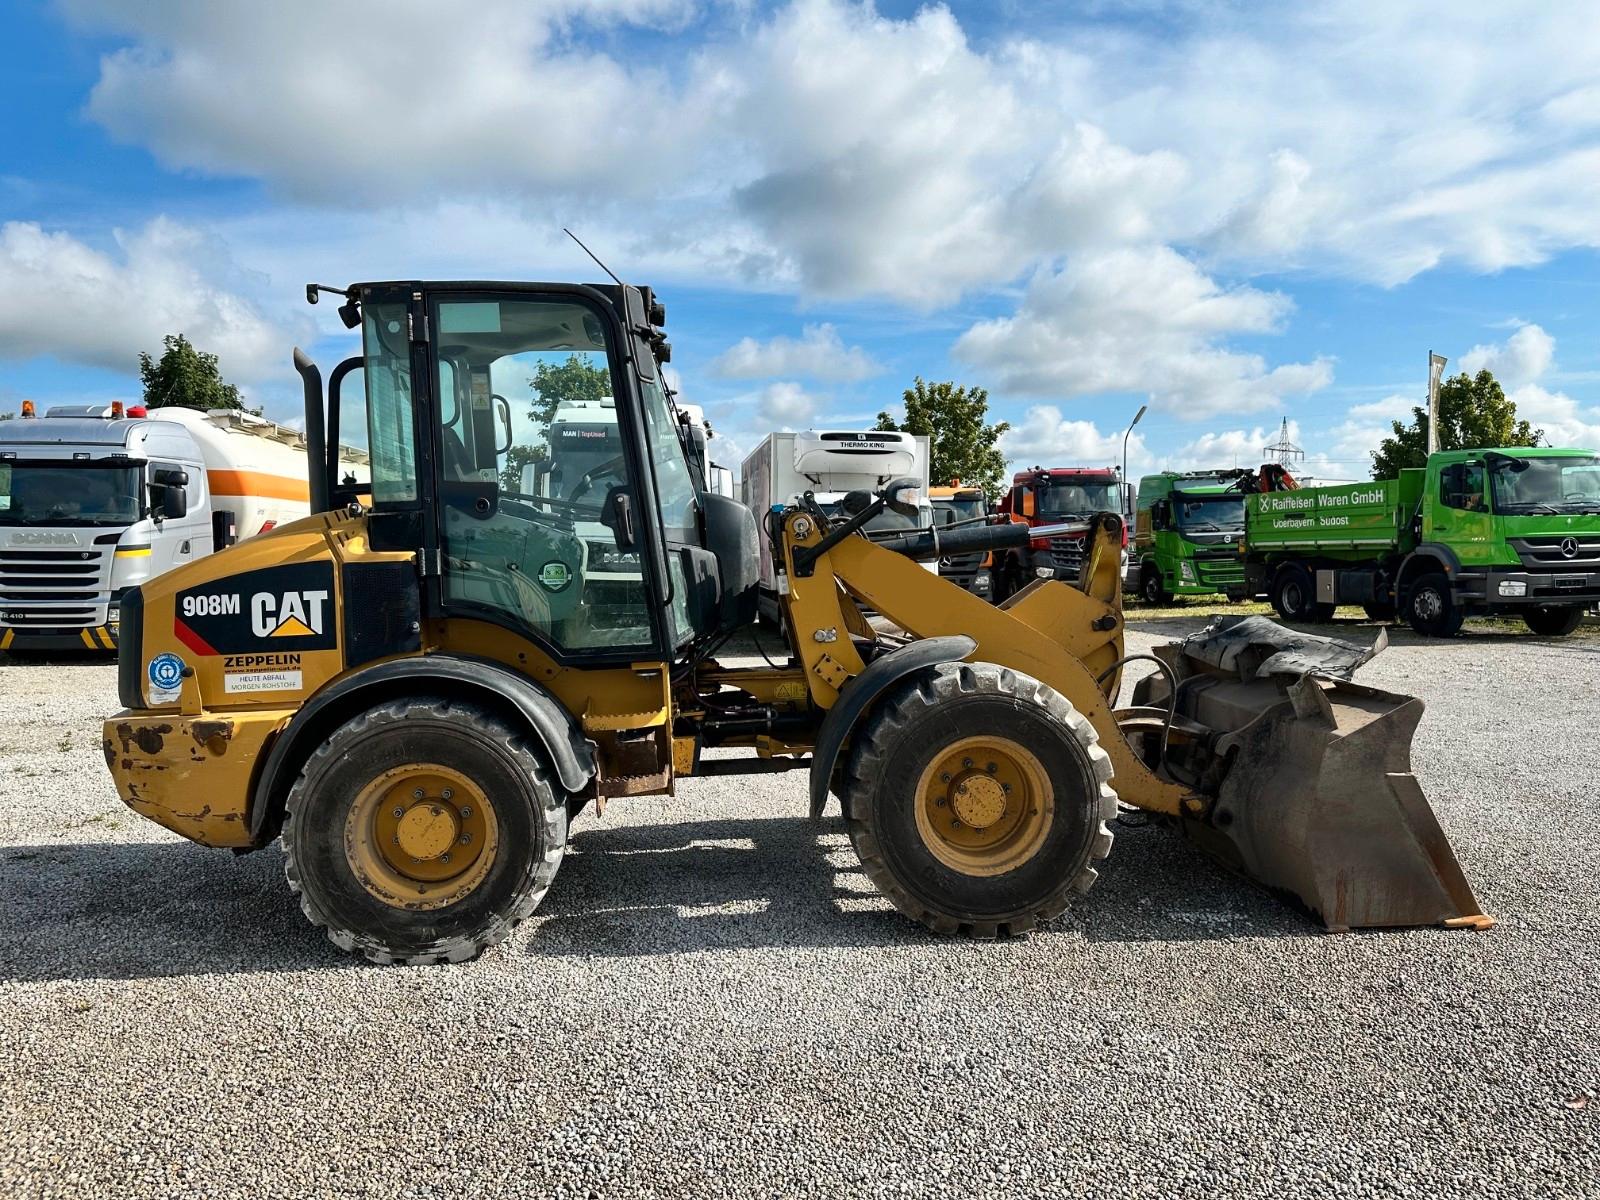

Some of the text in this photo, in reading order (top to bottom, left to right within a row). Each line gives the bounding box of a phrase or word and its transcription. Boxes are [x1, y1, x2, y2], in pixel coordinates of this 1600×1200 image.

[1272, 489, 1384, 510] Raiffeisen Waren GmbH
[183, 590, 328, 638] 908M CAT
[224, 653, 301, 667] ZEPPELIN
[262, 681, 296, 689] ROHSTOFF
